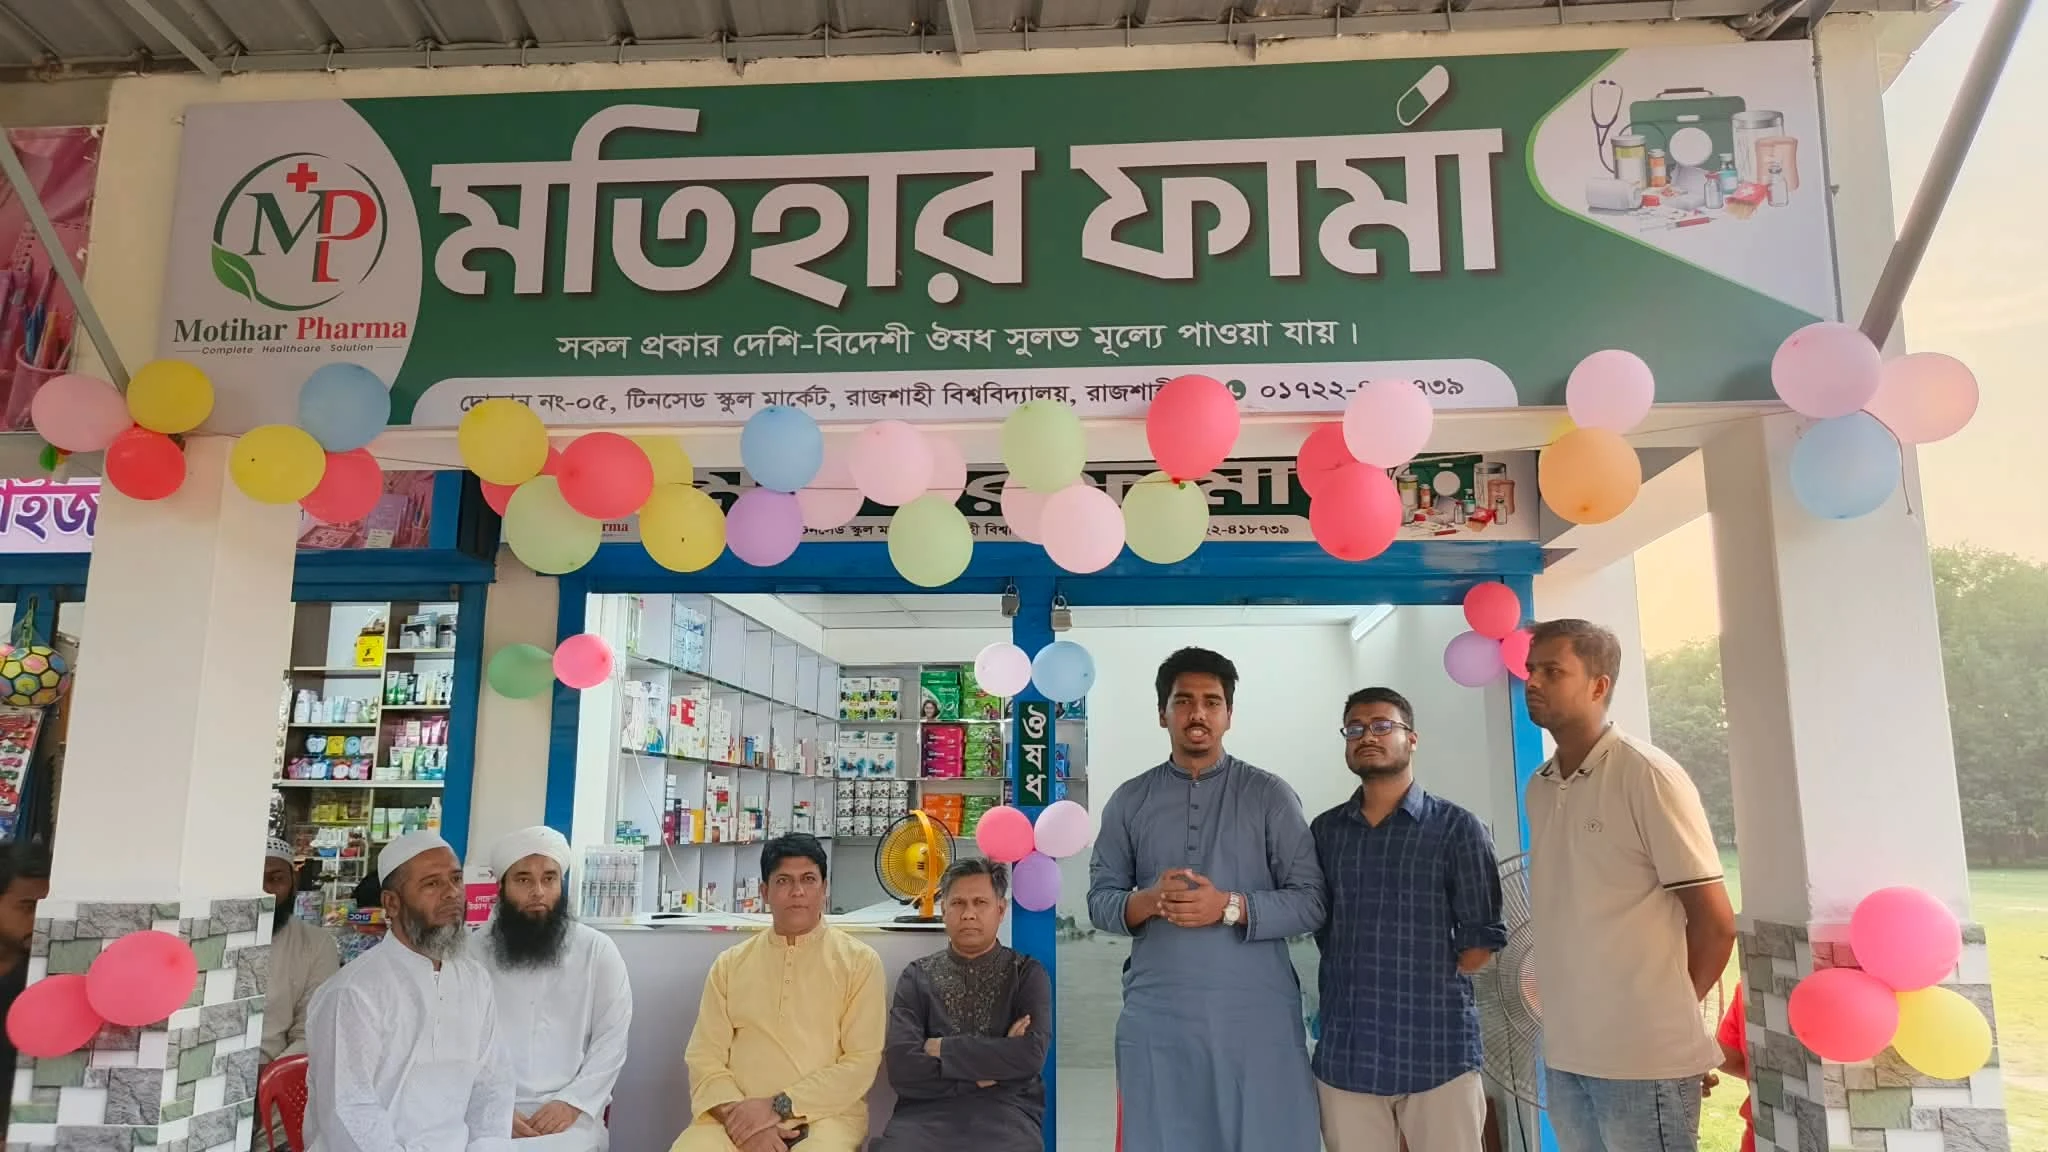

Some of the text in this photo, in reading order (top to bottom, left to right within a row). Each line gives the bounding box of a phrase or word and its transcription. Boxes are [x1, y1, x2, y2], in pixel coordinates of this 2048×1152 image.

[431, 104, 1036, 308] মতিহার
[173, 316, 408, 343] Motihar Pharma
[555, 336, 632, 360] সকল
[640, 333, 723, 359] প্রকার
[733, 322, 915, 358] দেশি-বিদেশী
[925, 321, 997, 353] ঔষধ
[1004, 327, 1081, 358] সুলভ
[1088, 324, 1168, 357] মূল্যে
[1178, 320, 1272, 347] পাওয়া
[1280, 318, 1339, 346] যায়
[202, 342, 374, 356] Complete Healthcare Solution
[540, 394, 617, 415] নং-০৫,
[626, 387, 707, 411] টিনসেড
[714, 391, 755, 414] স্কুল
[761, 384, 836, 411] মার্কেট,
[845, 382, 936, 408] রাজশাহী
[942, 380, 1076, 407] বিশ্ববিদ্যালয়,
[1085, 377, 1172, 403] রাজশা
[1260, 377, 1465, 400] ০১৭২২-৭৩৯
[849, 525, 874, 537] স্কুল
[1206, 524, 1290, 536] ২-৪১৮৭৩৯
